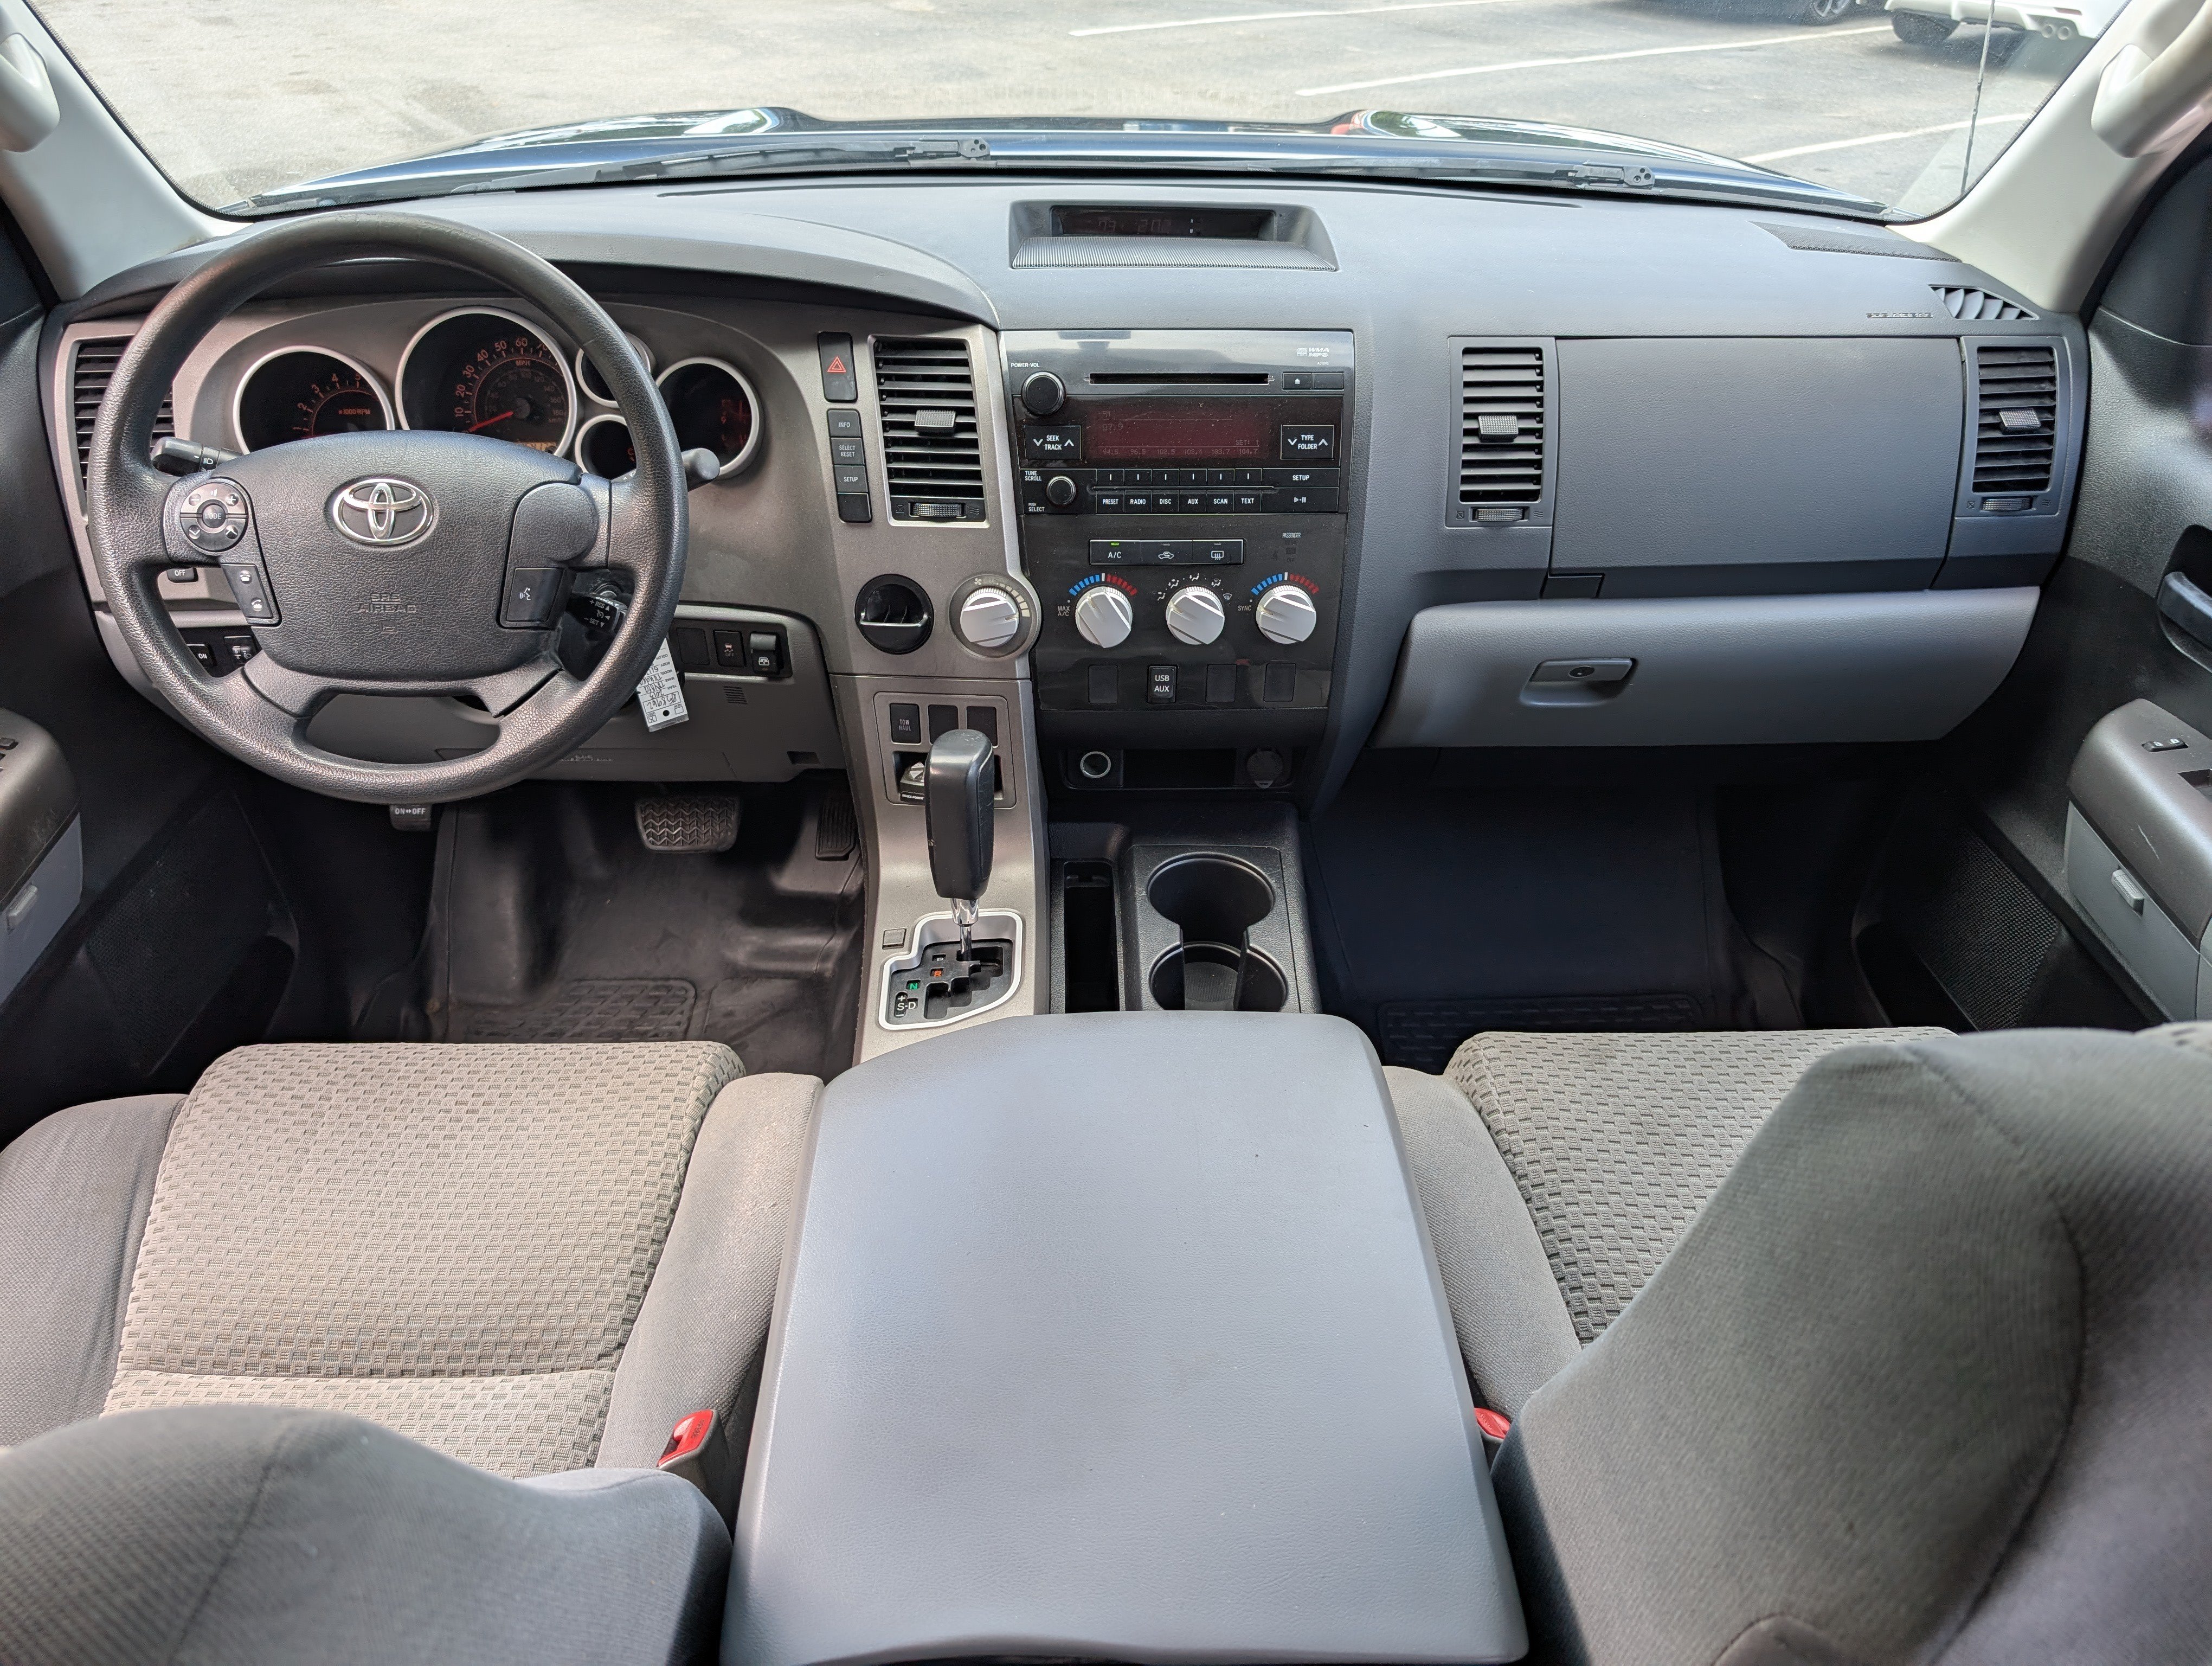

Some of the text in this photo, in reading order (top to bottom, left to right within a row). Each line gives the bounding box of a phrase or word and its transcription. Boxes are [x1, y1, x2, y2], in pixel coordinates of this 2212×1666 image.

[494, 340, 507, 351] 50
[516, 337, 528, 347] 60
[477, 349, 488, 362] 40
[463, 365, 475, 378] 30
[332, 373, 338, 382] 4
[311, 384, 320, 393] 3
[455, 384, 466, 397] 20
[298, 402, 307, 411] 2
[454, 407, 464, 417] 10
[370, 593, 401, 601] SRS
[358, 604, 416, 613] AIRBAG
[589, 618, 600, 626] SET
